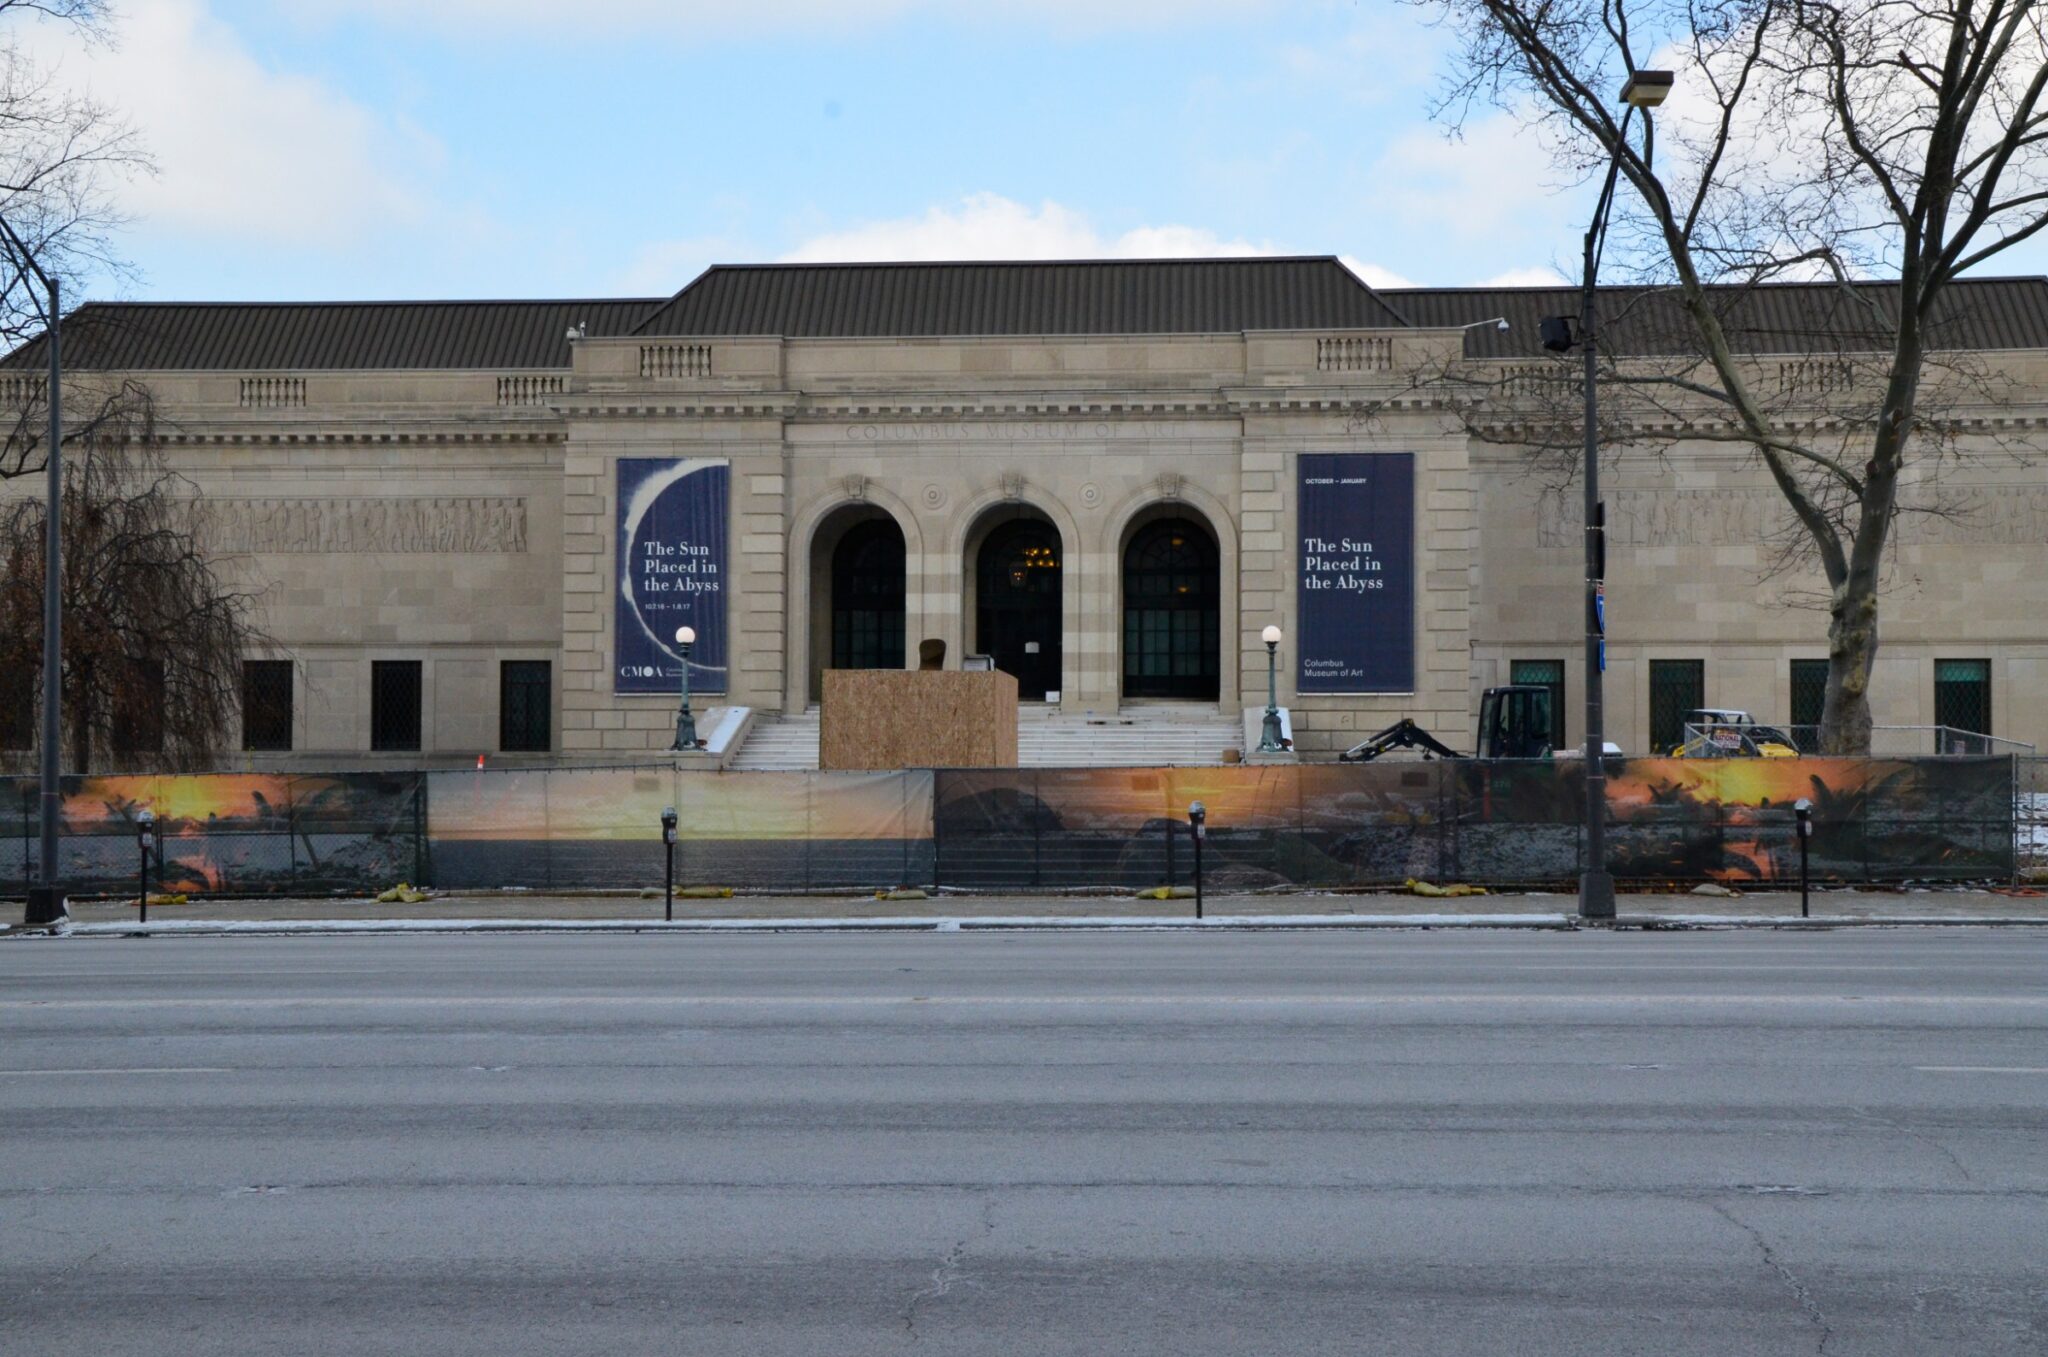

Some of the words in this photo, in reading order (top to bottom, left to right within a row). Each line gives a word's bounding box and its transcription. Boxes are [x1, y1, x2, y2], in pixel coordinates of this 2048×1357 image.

[846, 423, 968, 440] COLUMBUS
[986, 422, 1079, 439] MUSEUM
[1095, 422, 1123, 438] OF
[1138, 422, 1179, 437] ART
[644, 541, 675, 556] The
[679, 541, 710, 556] Sun
[1305, 538, 1336, 553] The
[1341, 538, 1373, 553] Sun
[644, 559, 697, 574] Placed
[702, 559, 718, 574] in
[1305, 556, 1360, 571] Placed
[1365, 556, 1381, 571] in
[644, 577, 669, 592] the
[674, 577, 719, 596] Abyss
[1305, 575, 1331, 589] the
[1336, 575, 1384, 594] Abyss
[1304, 659, 1344, 668] Columbus
[1305, 669, 1338, 678] Museum
[1340, 669, 1349, 678] of
[1351, 669, 1364, 678] Art
